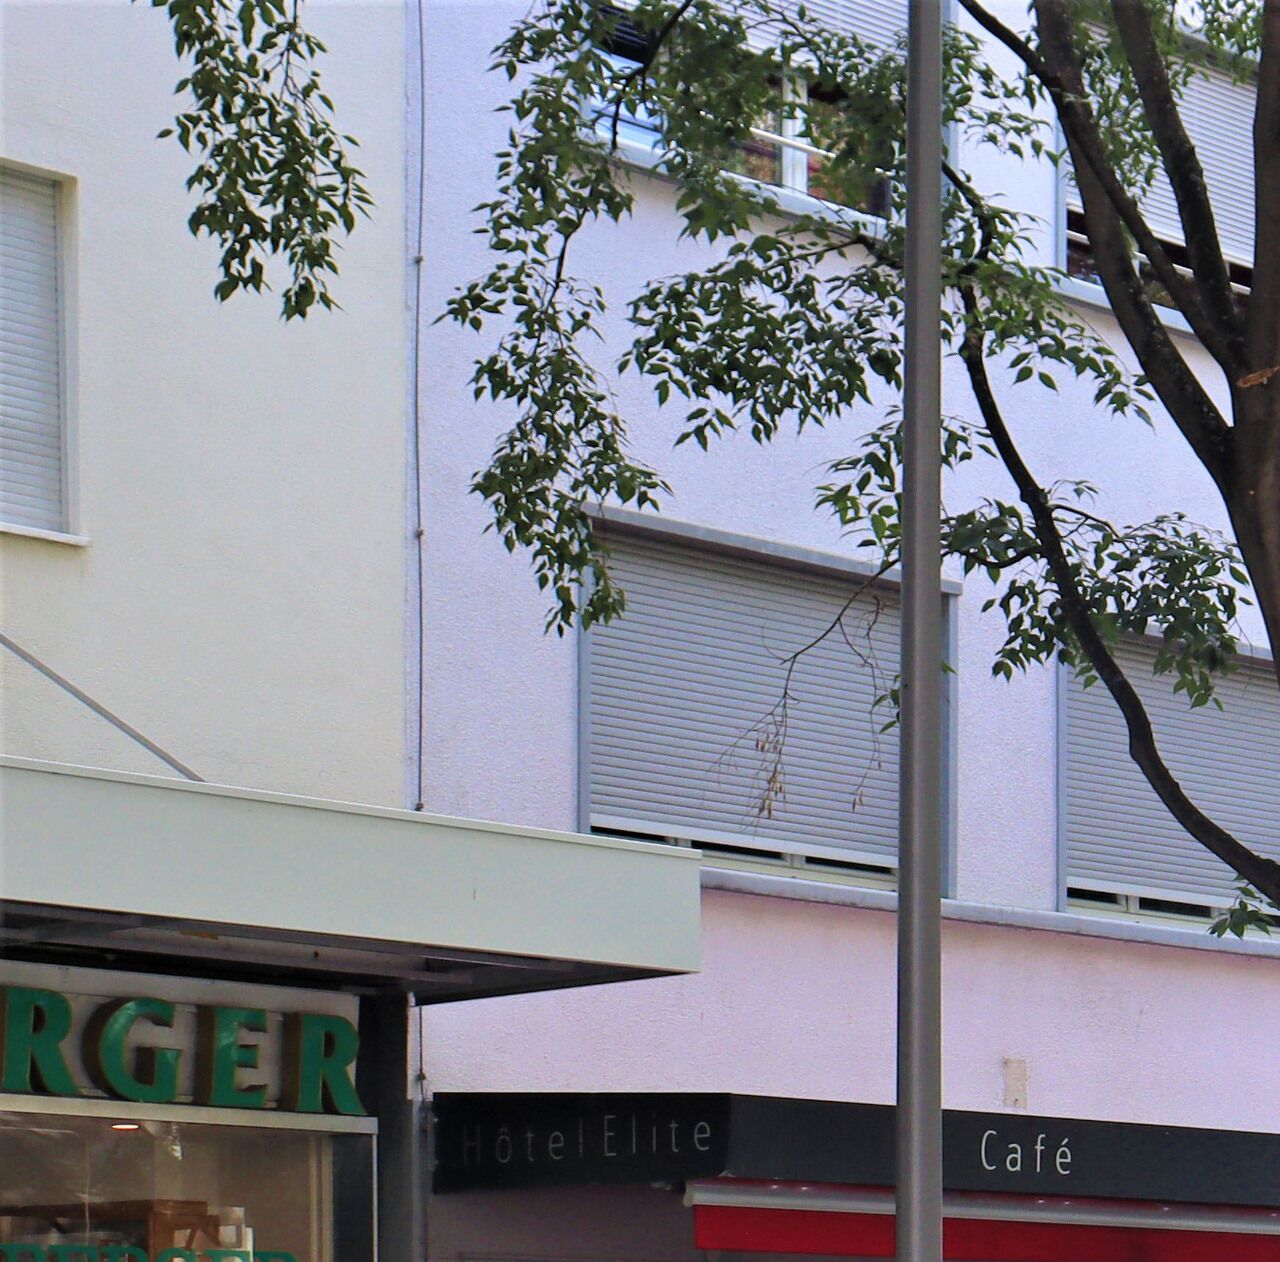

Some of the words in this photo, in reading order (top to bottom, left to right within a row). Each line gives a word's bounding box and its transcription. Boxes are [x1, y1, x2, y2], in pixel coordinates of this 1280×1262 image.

[463, 1117, 584, 1166] Hôtel
[604, 1113, 712, 1158] Elite
[981, 1130, 1072, 1175] Café
